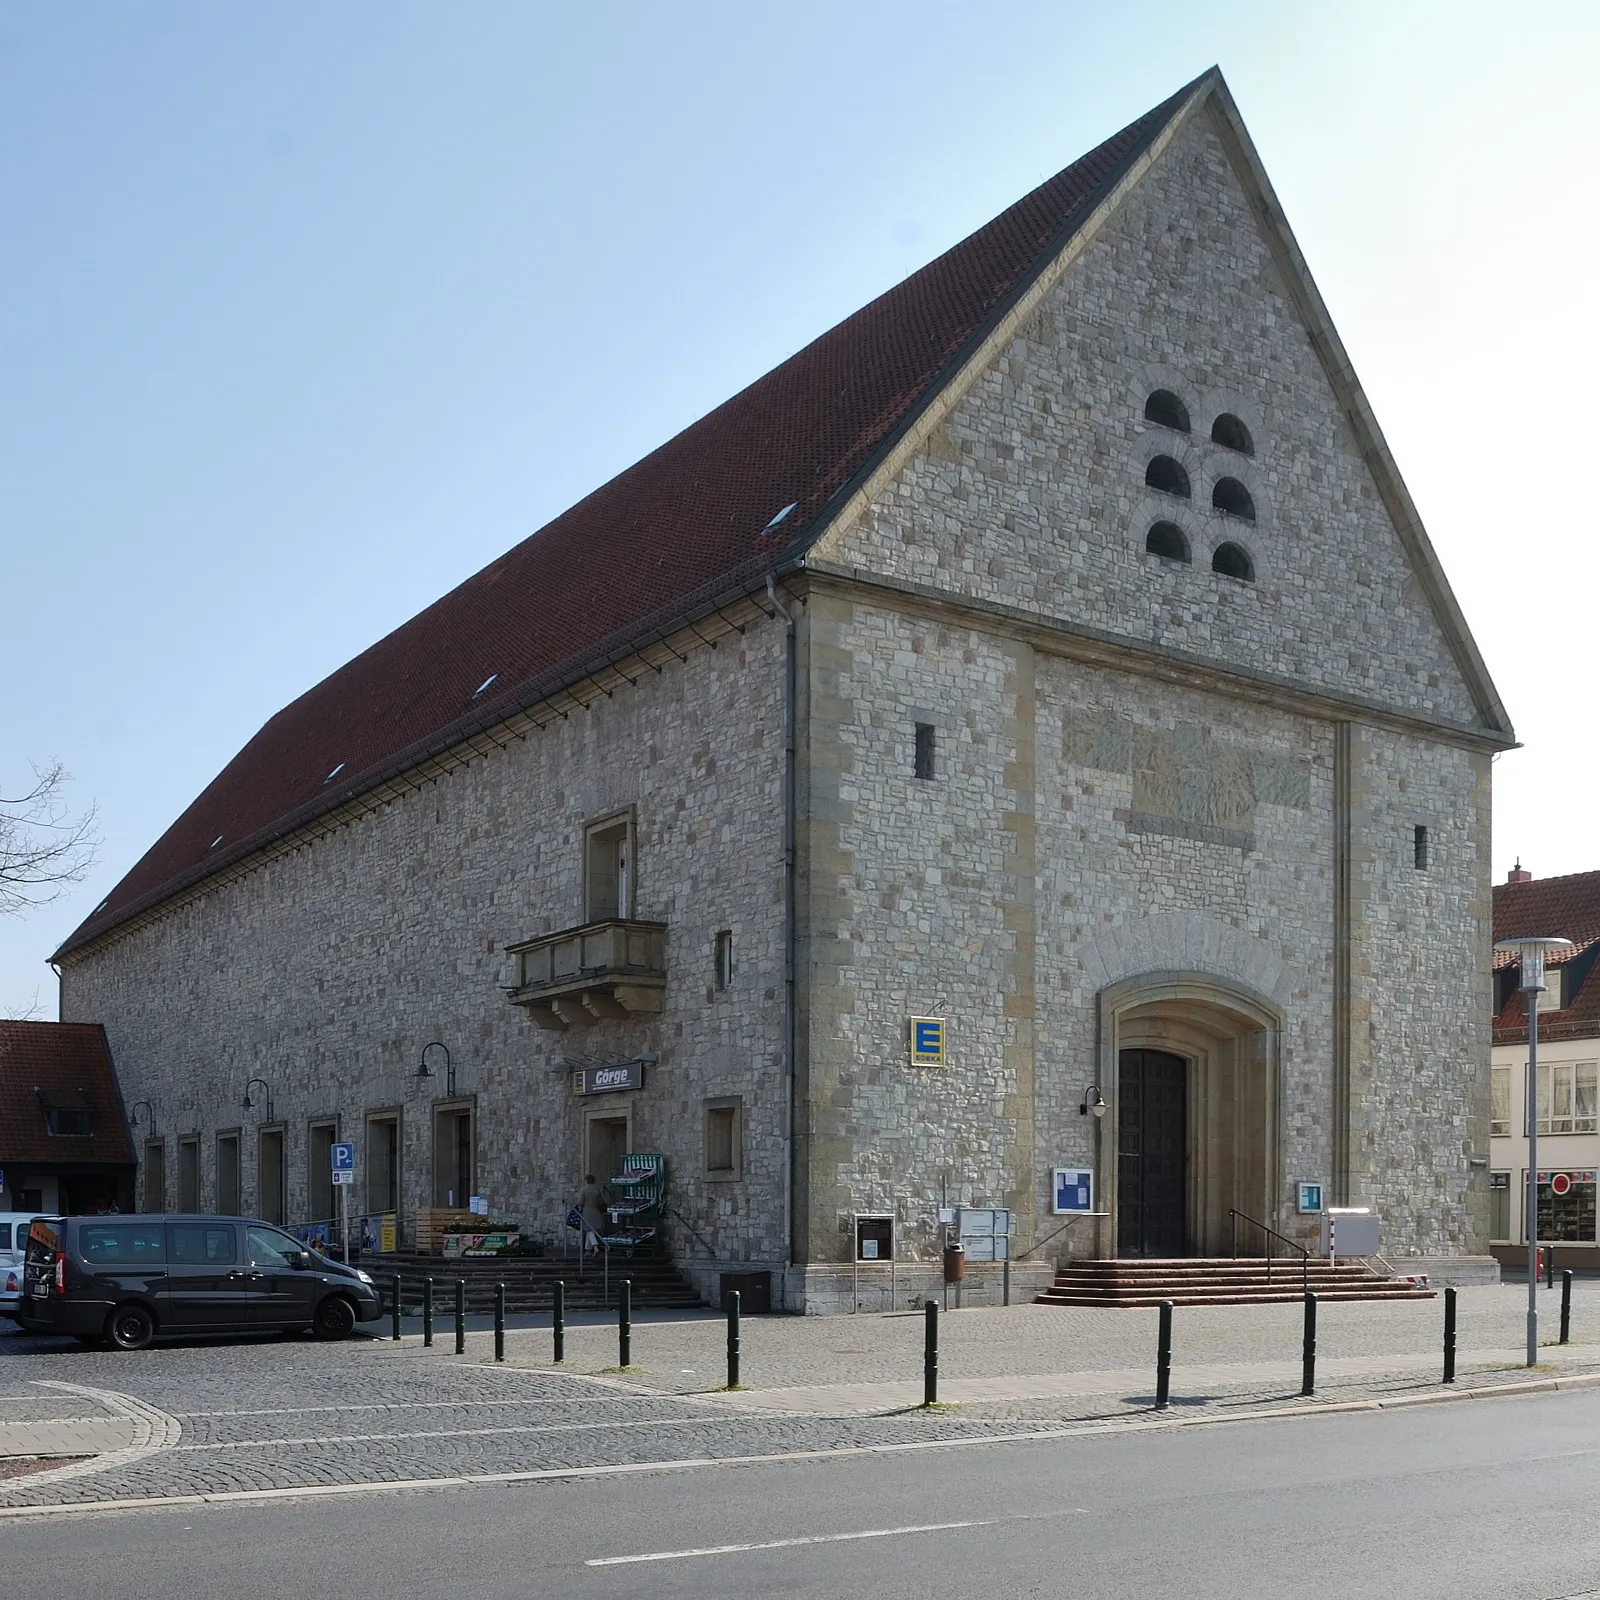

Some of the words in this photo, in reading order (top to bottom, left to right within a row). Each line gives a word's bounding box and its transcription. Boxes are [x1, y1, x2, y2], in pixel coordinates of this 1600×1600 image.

[916, 1022, 941, 1053] E
[595, 1069, 628, 1084] Görge
[336, 1147, 348, 1166] P
